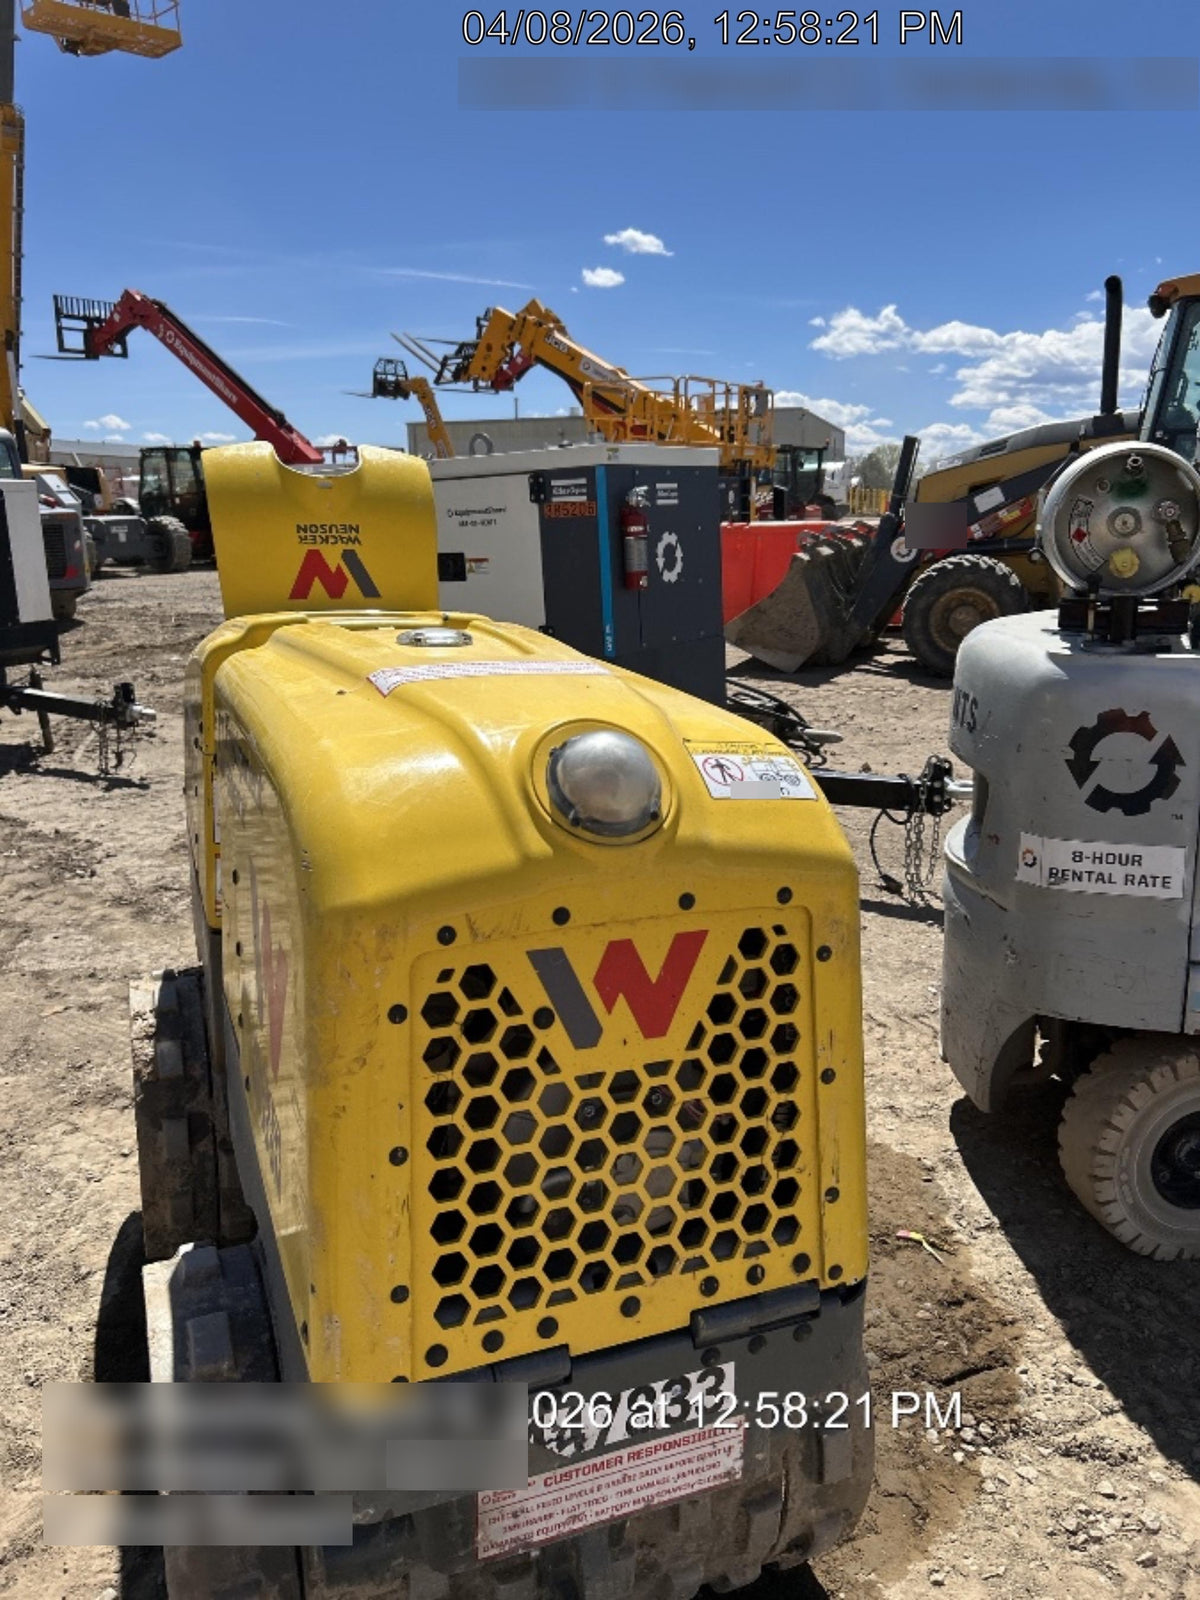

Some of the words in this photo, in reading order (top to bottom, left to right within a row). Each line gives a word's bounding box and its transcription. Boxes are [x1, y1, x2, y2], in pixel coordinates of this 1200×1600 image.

[296, 523, 360, 534] NEUSON
[298, 534, 362, 546] WACKER
[1071, 850, 1143, 867] 8-HOUR
[1049, 866, 1118, 885] RENTAL
[1124, 873, 1173, 890] RATE
[543, 1456, 623, 1488] CUSTOMER
